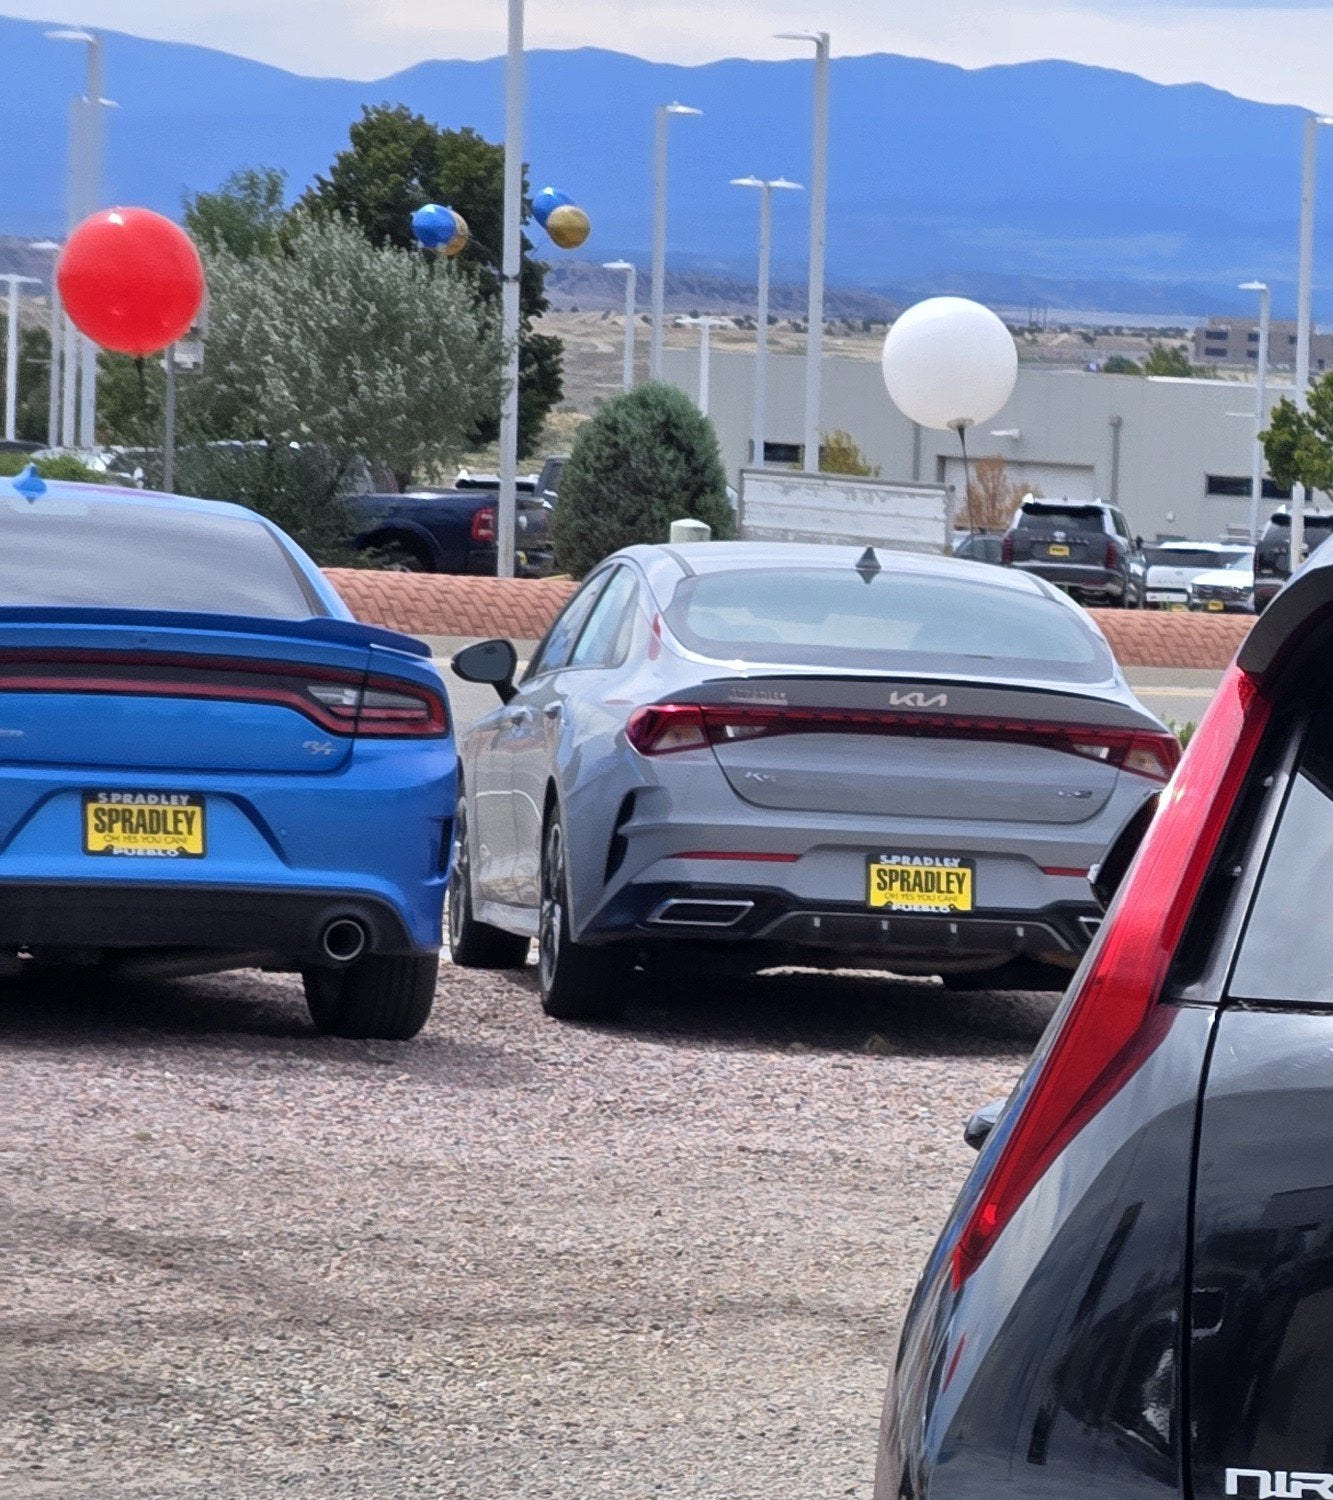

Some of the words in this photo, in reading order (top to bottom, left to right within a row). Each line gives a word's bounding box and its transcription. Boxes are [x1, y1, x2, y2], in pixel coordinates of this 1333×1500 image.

[97, 792, 190, 806] SPRADLEY
[93, 807, 196, 836] SPRADLEY
[122, 835, 138, 844] YES
[140, 835, 162, 844] YOU
[112, 847, 180, 857] PUEBLO
[880, 854, 961, 868] SPRADLEY
[876, 868, 967, 895] SPRADLEY
[900, 893, 915, 901] YES
[917, 894, 936, 902] YOU
